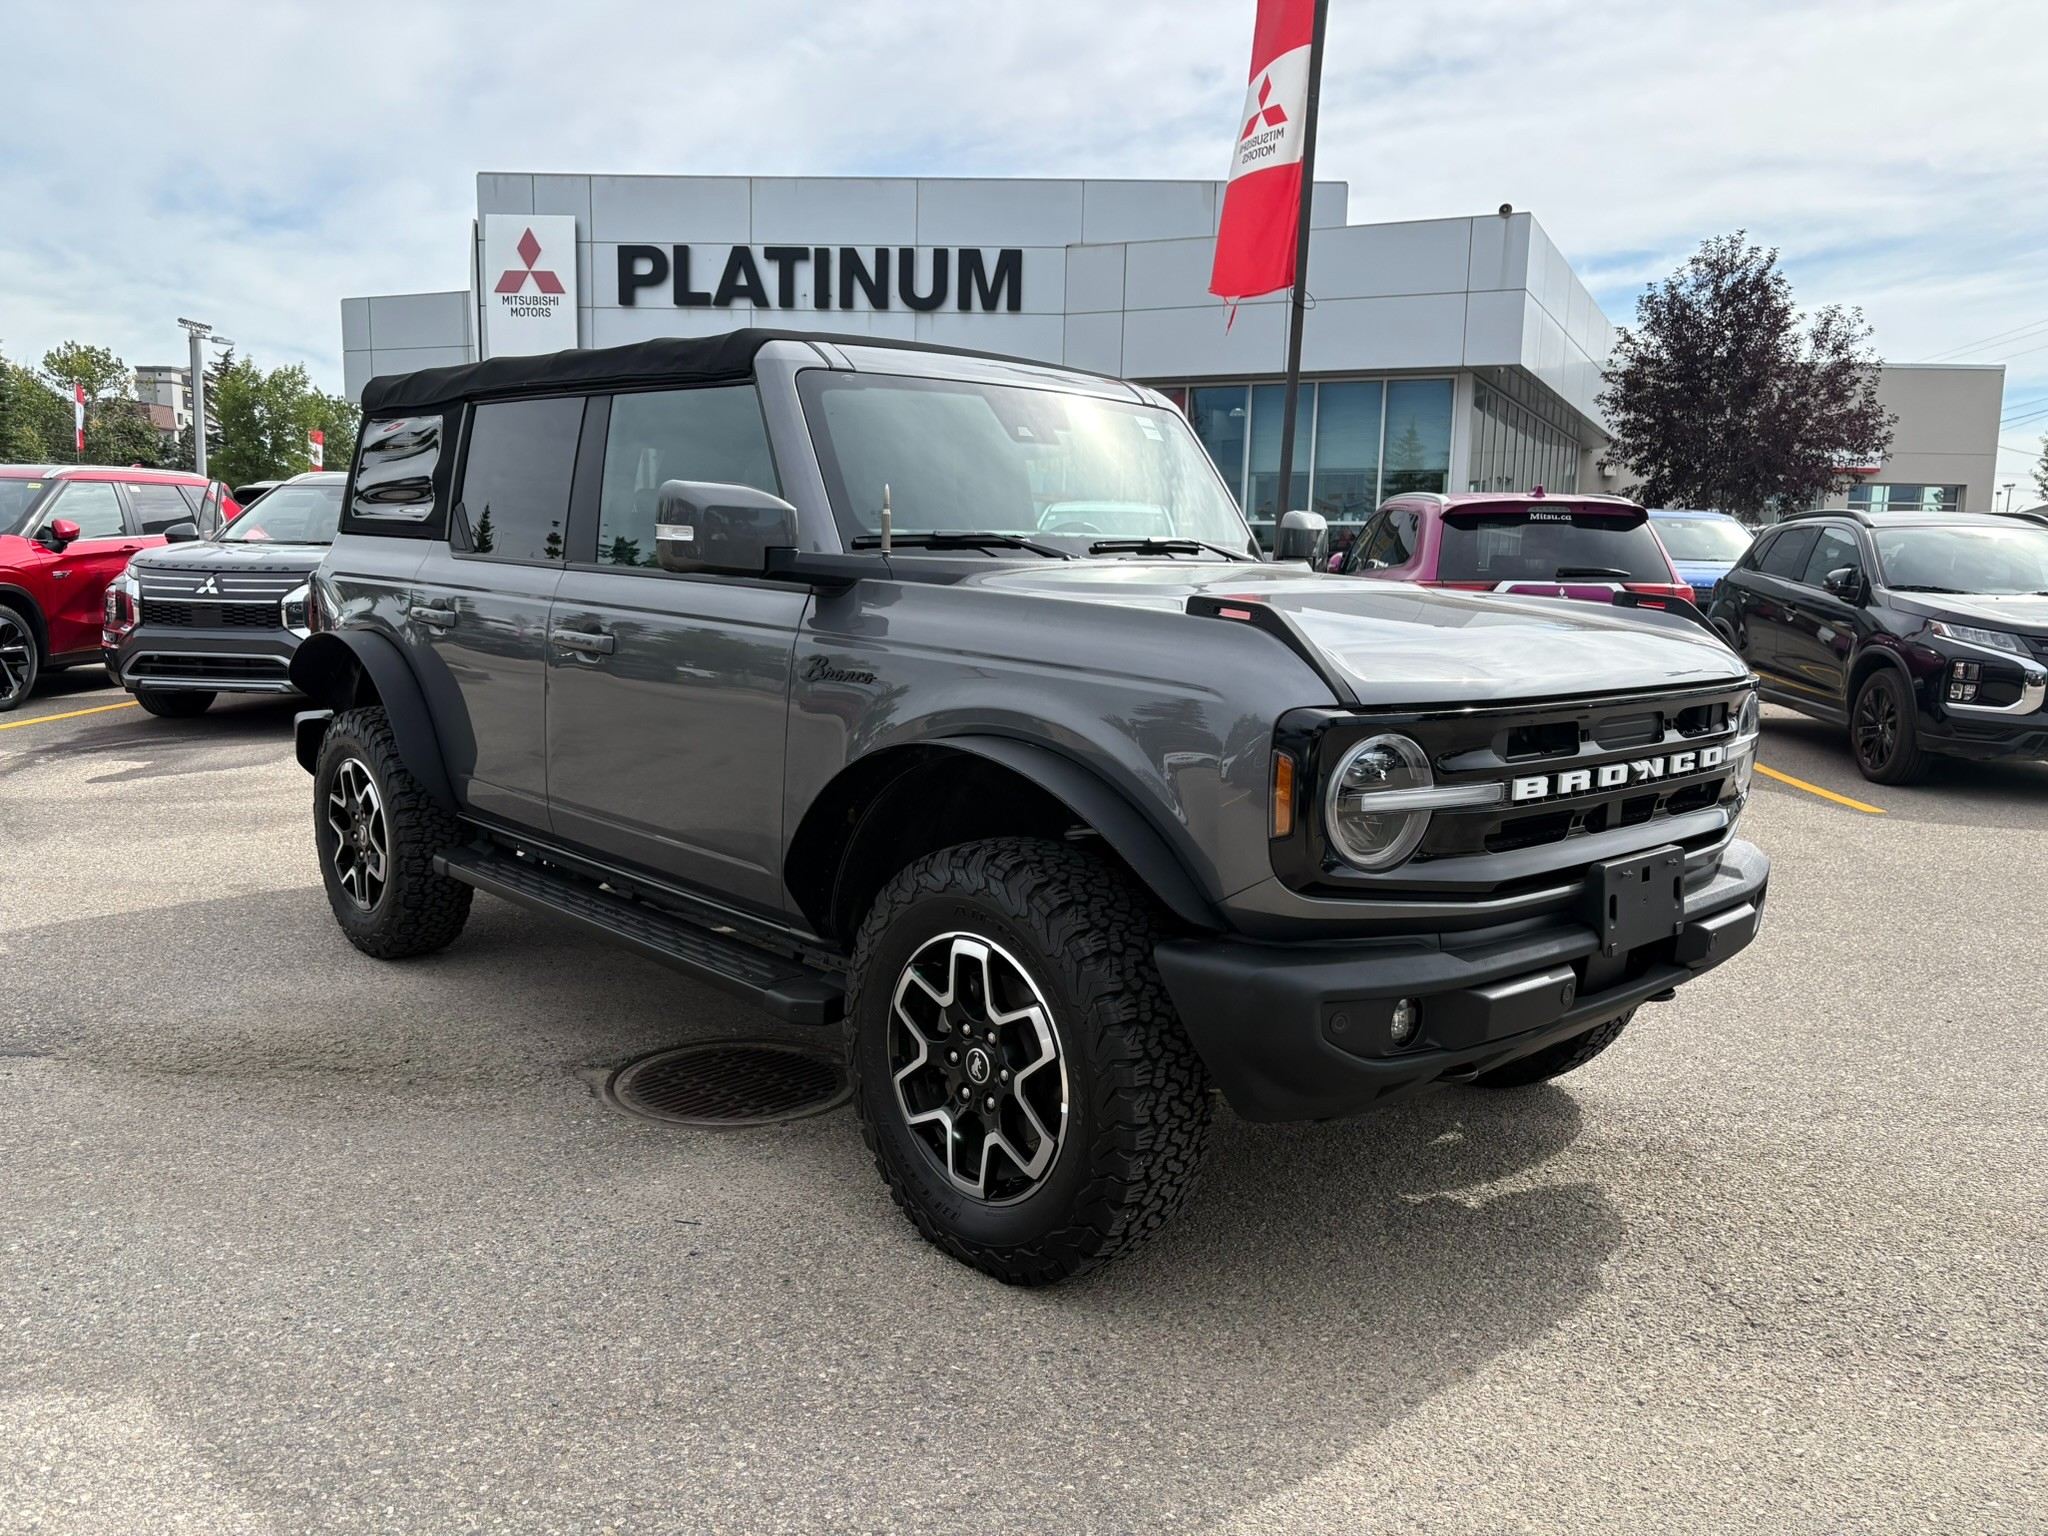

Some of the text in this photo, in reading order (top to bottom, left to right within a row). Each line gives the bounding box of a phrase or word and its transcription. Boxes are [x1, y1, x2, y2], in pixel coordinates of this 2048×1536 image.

[617, 244, 1023, 312] PLATINUM
[502, 295, 559, 306] MITSUBISHI
[510, 307, 552, 318] MOTORS
[1529, 512, 1573, 521] Mitsu.ca
[800, 654, 878, 684] Bronco
[1511, 746, 1724, 801] BRONCO
